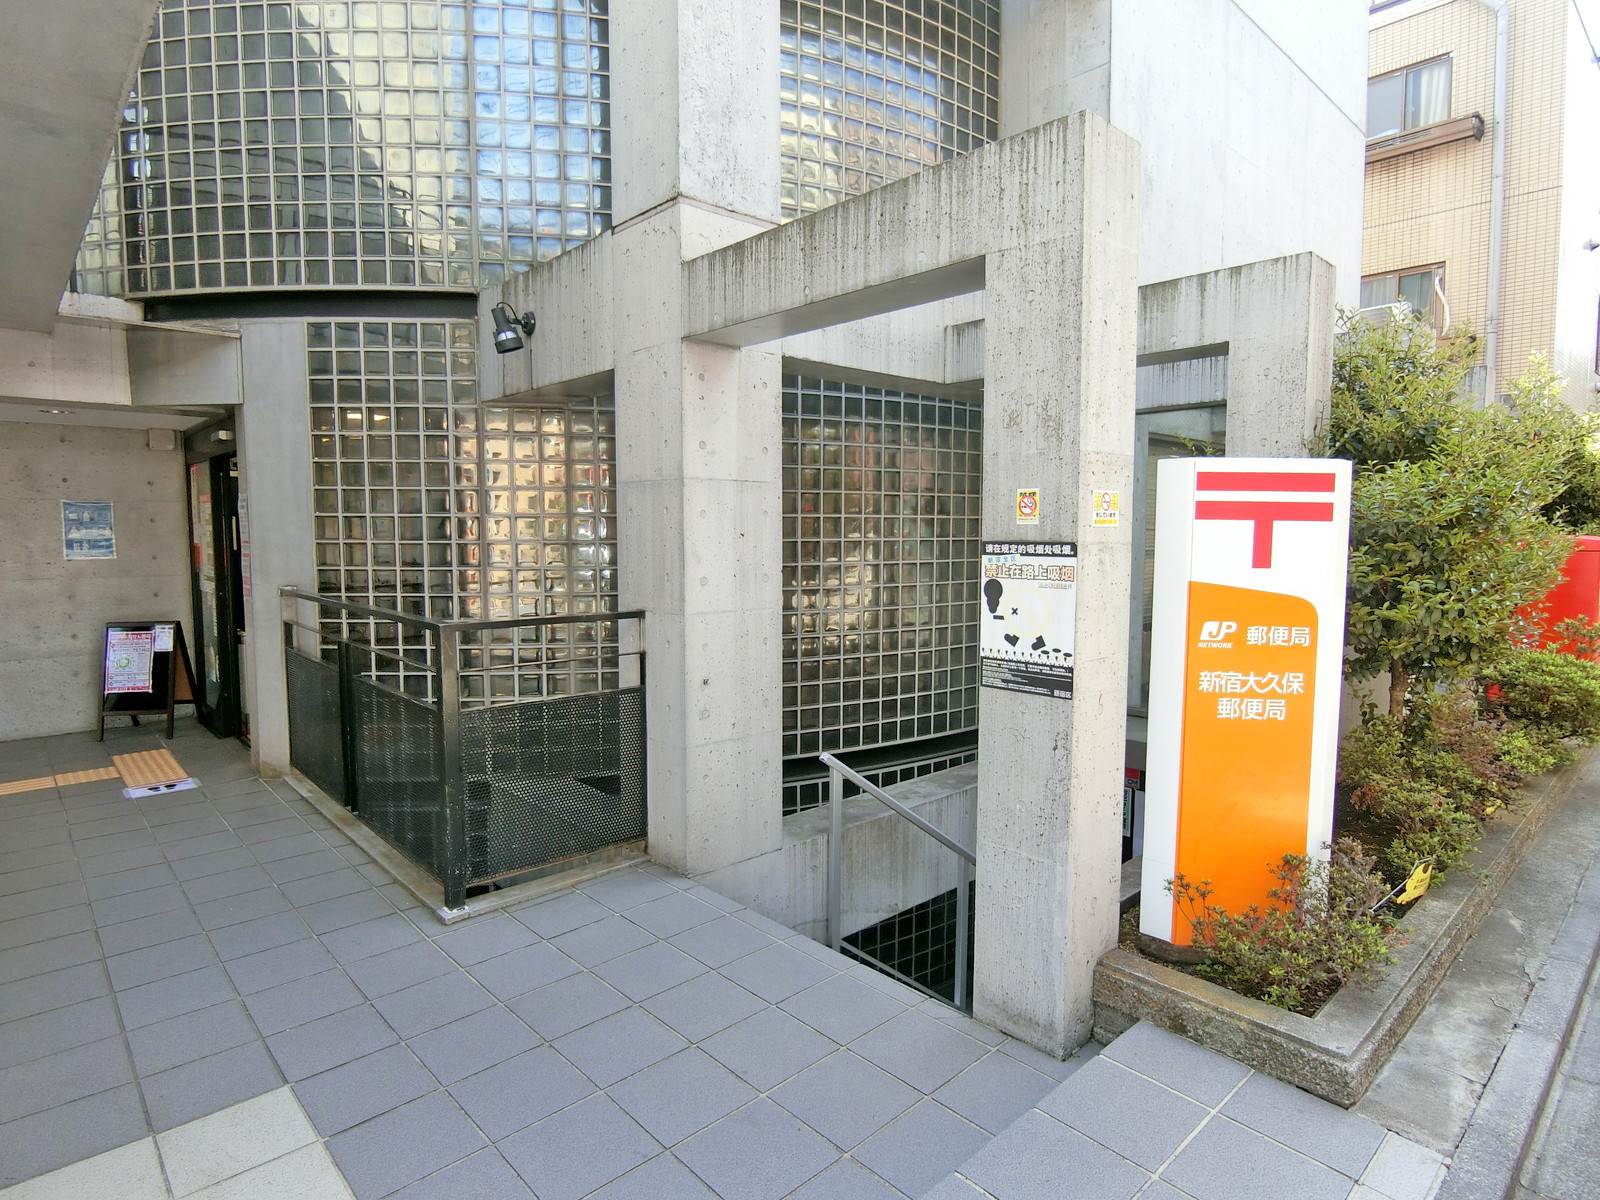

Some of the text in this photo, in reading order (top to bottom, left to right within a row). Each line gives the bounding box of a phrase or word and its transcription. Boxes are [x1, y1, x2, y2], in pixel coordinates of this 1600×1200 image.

[985, 563, 1075, 582] 禁止在路上吸烟
[1246, 625, 1310, 647] 郵便局
[1198, 670, 1305, 695] 新宿大久保
[1217, 697, 1287, 721] 郵便局
